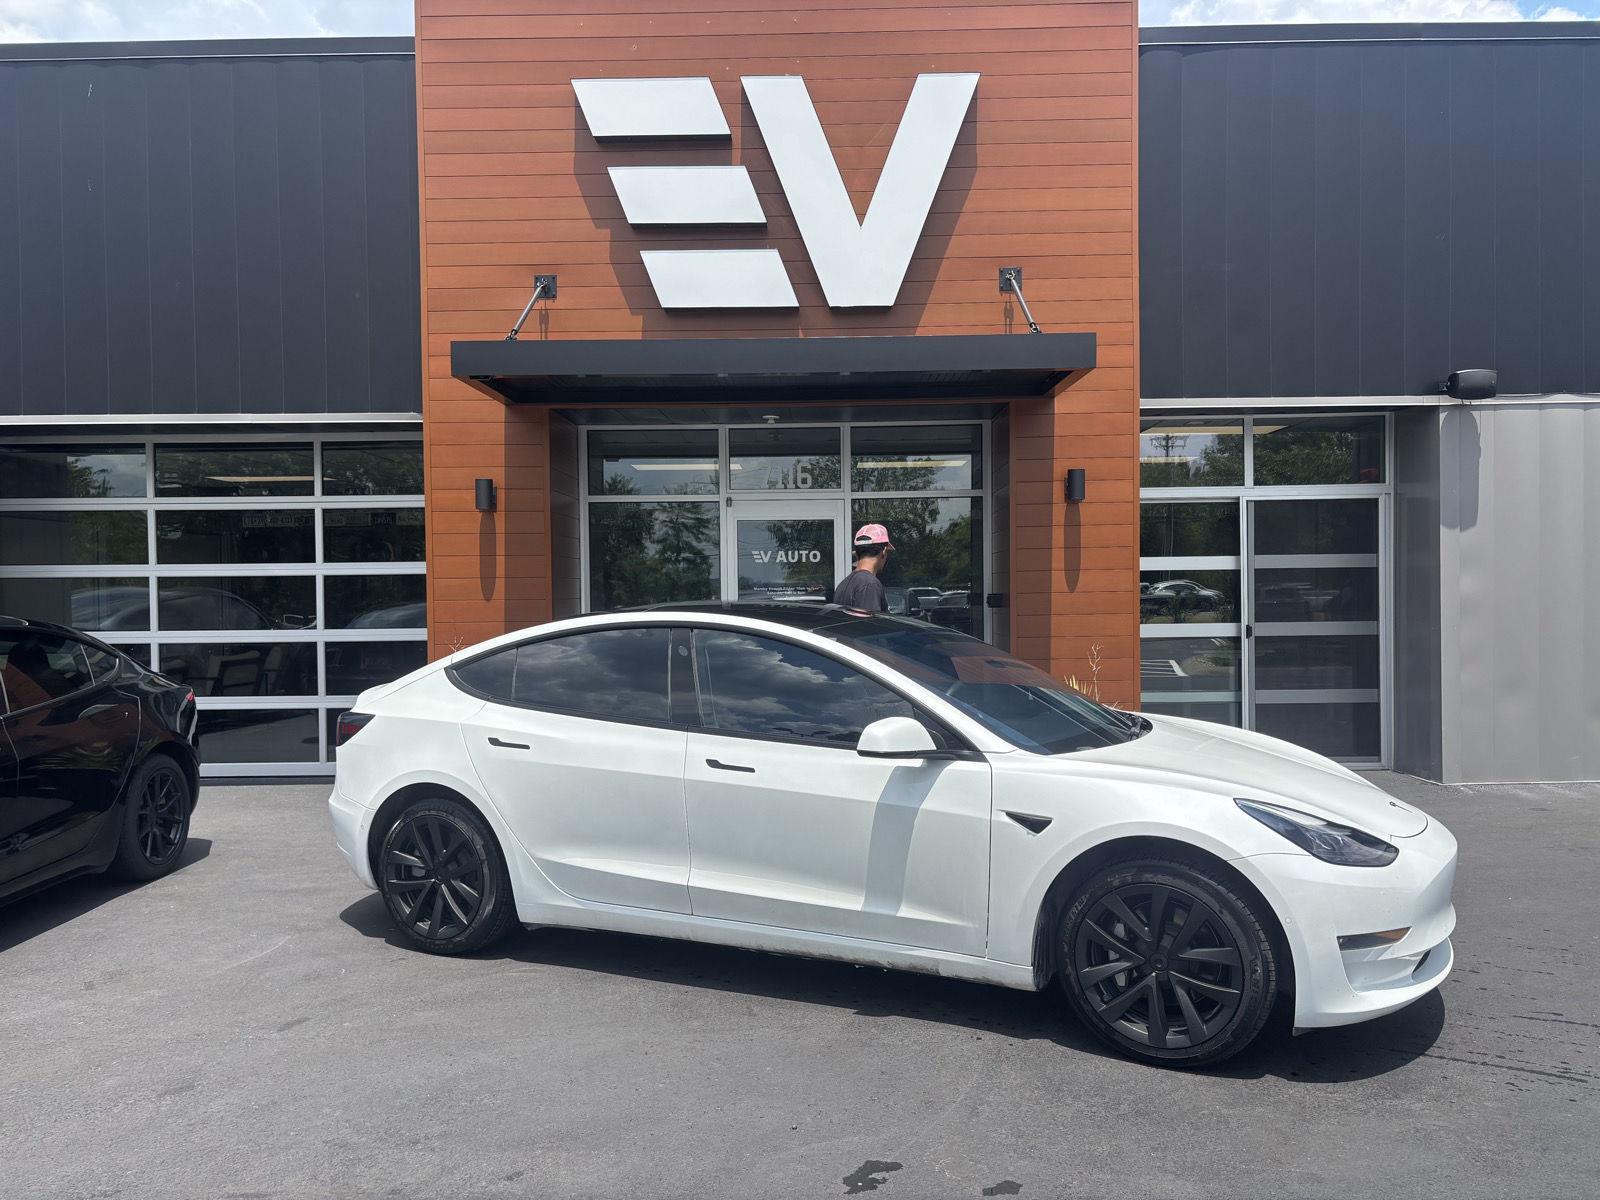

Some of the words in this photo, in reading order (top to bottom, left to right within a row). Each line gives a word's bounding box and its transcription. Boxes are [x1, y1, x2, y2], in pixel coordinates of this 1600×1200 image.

[571, 73, 981, 308] EV
[752, 550, 772, 563] EV
[775, 550, 821, 563] AUTO
